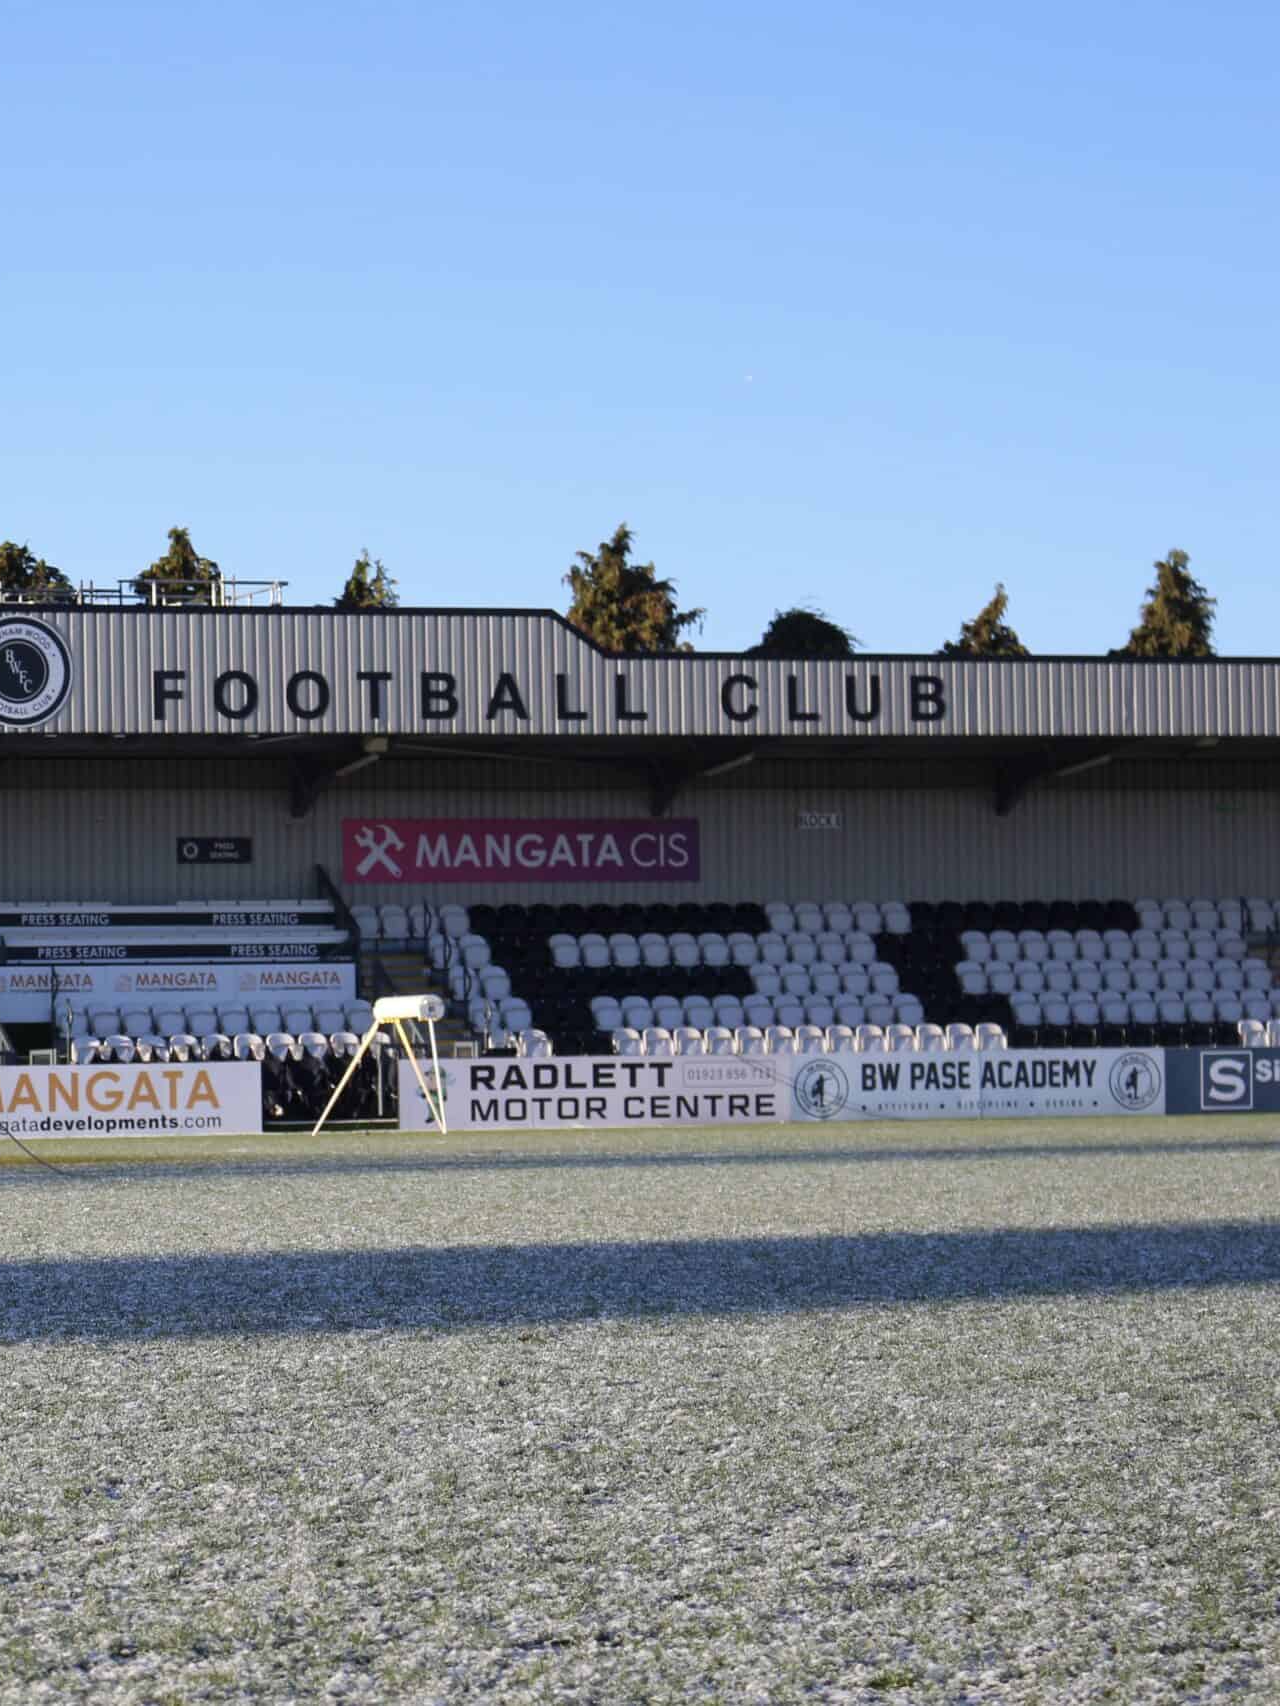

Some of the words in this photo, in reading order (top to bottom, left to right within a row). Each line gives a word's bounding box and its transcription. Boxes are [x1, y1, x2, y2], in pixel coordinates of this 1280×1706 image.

[153, 670, 648, 721] FOOTBALL
[721, 674, 947, 722] CLUB
[415, 833, 623, 867] MANGATA
[630, 833, 689, 868] CIS
[21, 914, 56, 927] PRESS
[58, 914, 110, 926] SEATING
[212, 913, 246, 926] PRESS
[249, 913, 299, 925] SEATING
[38, 947, 73, 959] PRESS
[75, 947, 127, 958] SEATING
[231, 945, 265, 957] PRESS
[267, 945, 318, 957] SEATING
[136, 972, 217, 986] MANGATA
[260, 971, 341, 985] MANGATA
[470, 1062, 673, 1091] RADLETT
[861, 1062, 901, 1091] BW
[910, 1061, 971, 1090] PASE
[980, 1059, 1097, 1089] ACADEMY
[471, 1096, 607, 1122] MOTOR
[623, 1093, 776, 1119] CENTRE
